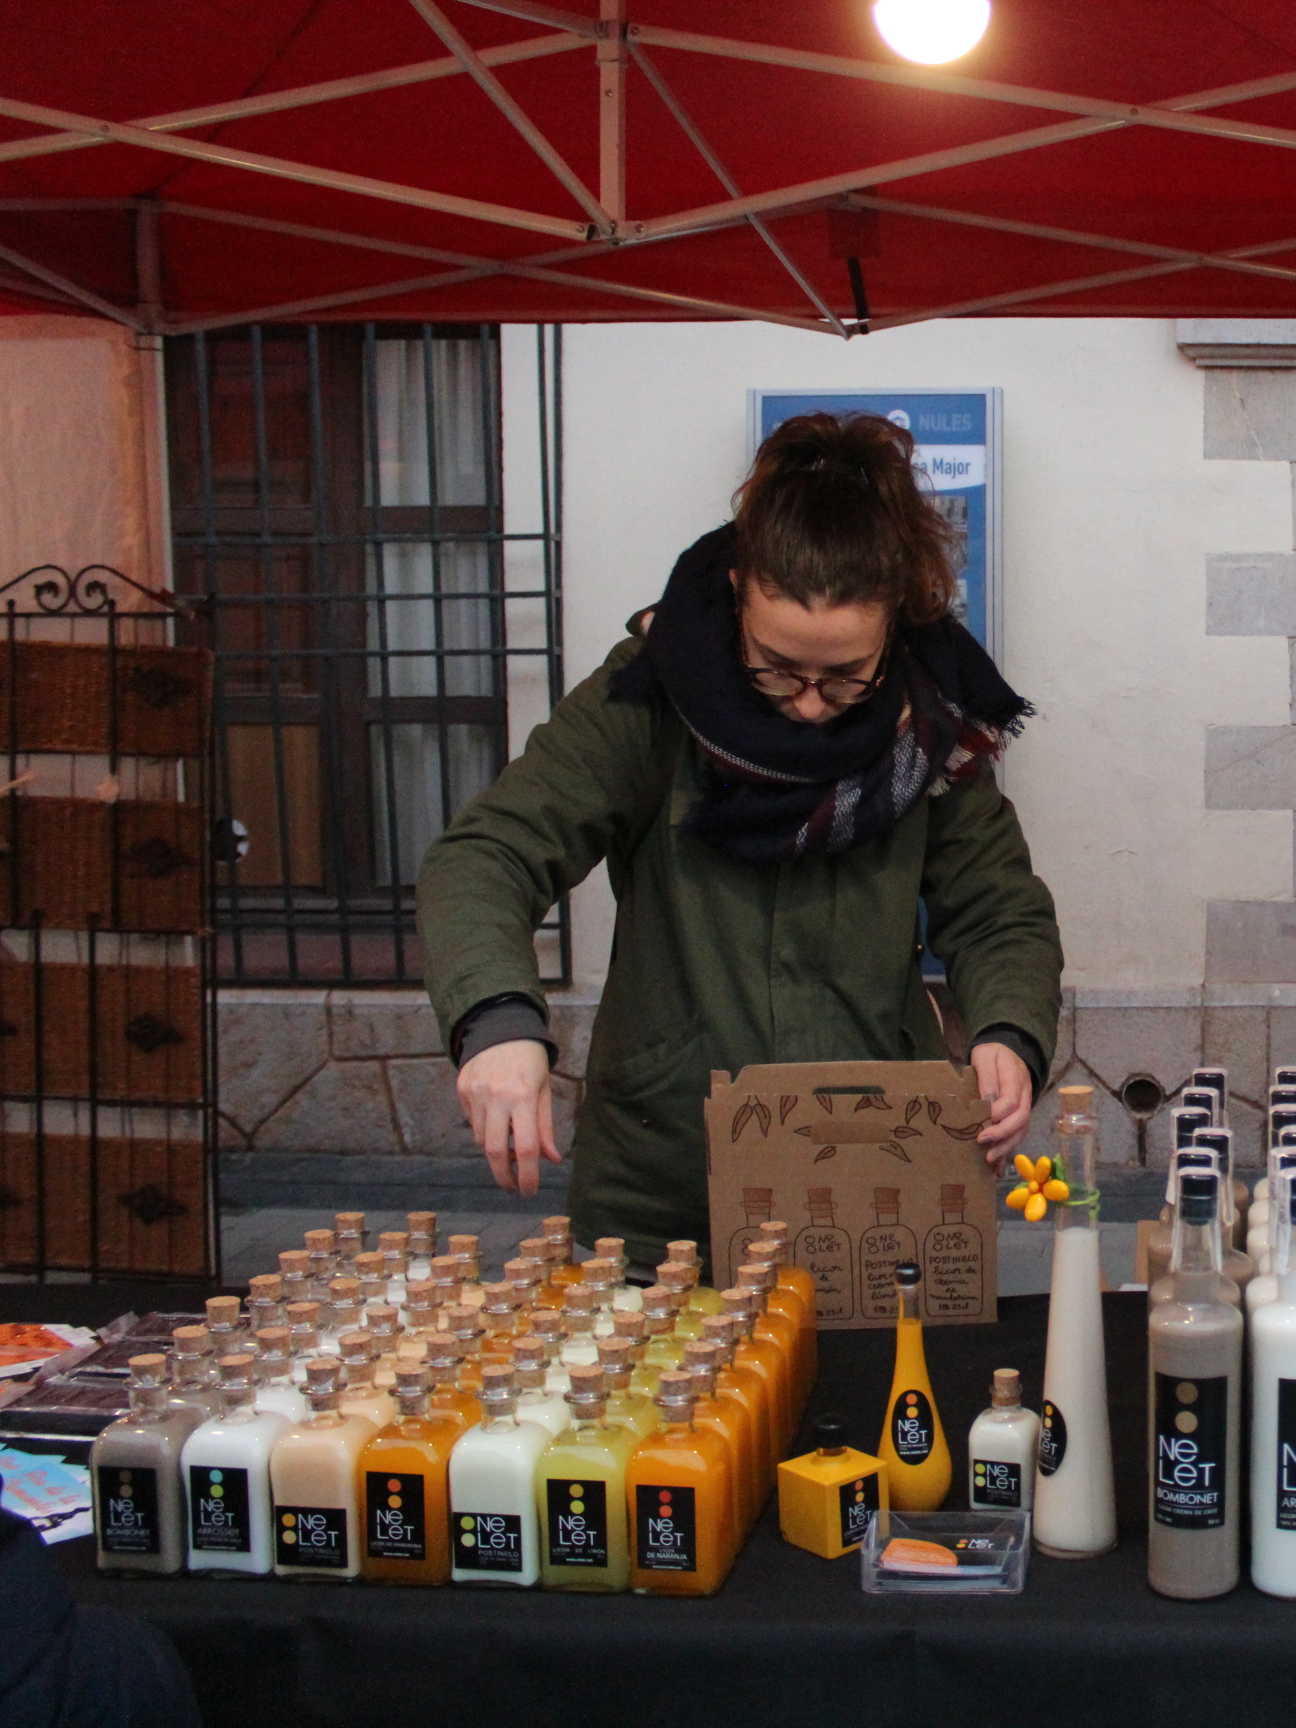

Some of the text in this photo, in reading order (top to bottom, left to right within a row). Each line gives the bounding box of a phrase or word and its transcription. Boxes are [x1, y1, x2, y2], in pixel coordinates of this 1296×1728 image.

[918, 414, 973, 432] NULES
[932, 457, 971, 479] Major
[646, 1551, 658, 1559] DE
